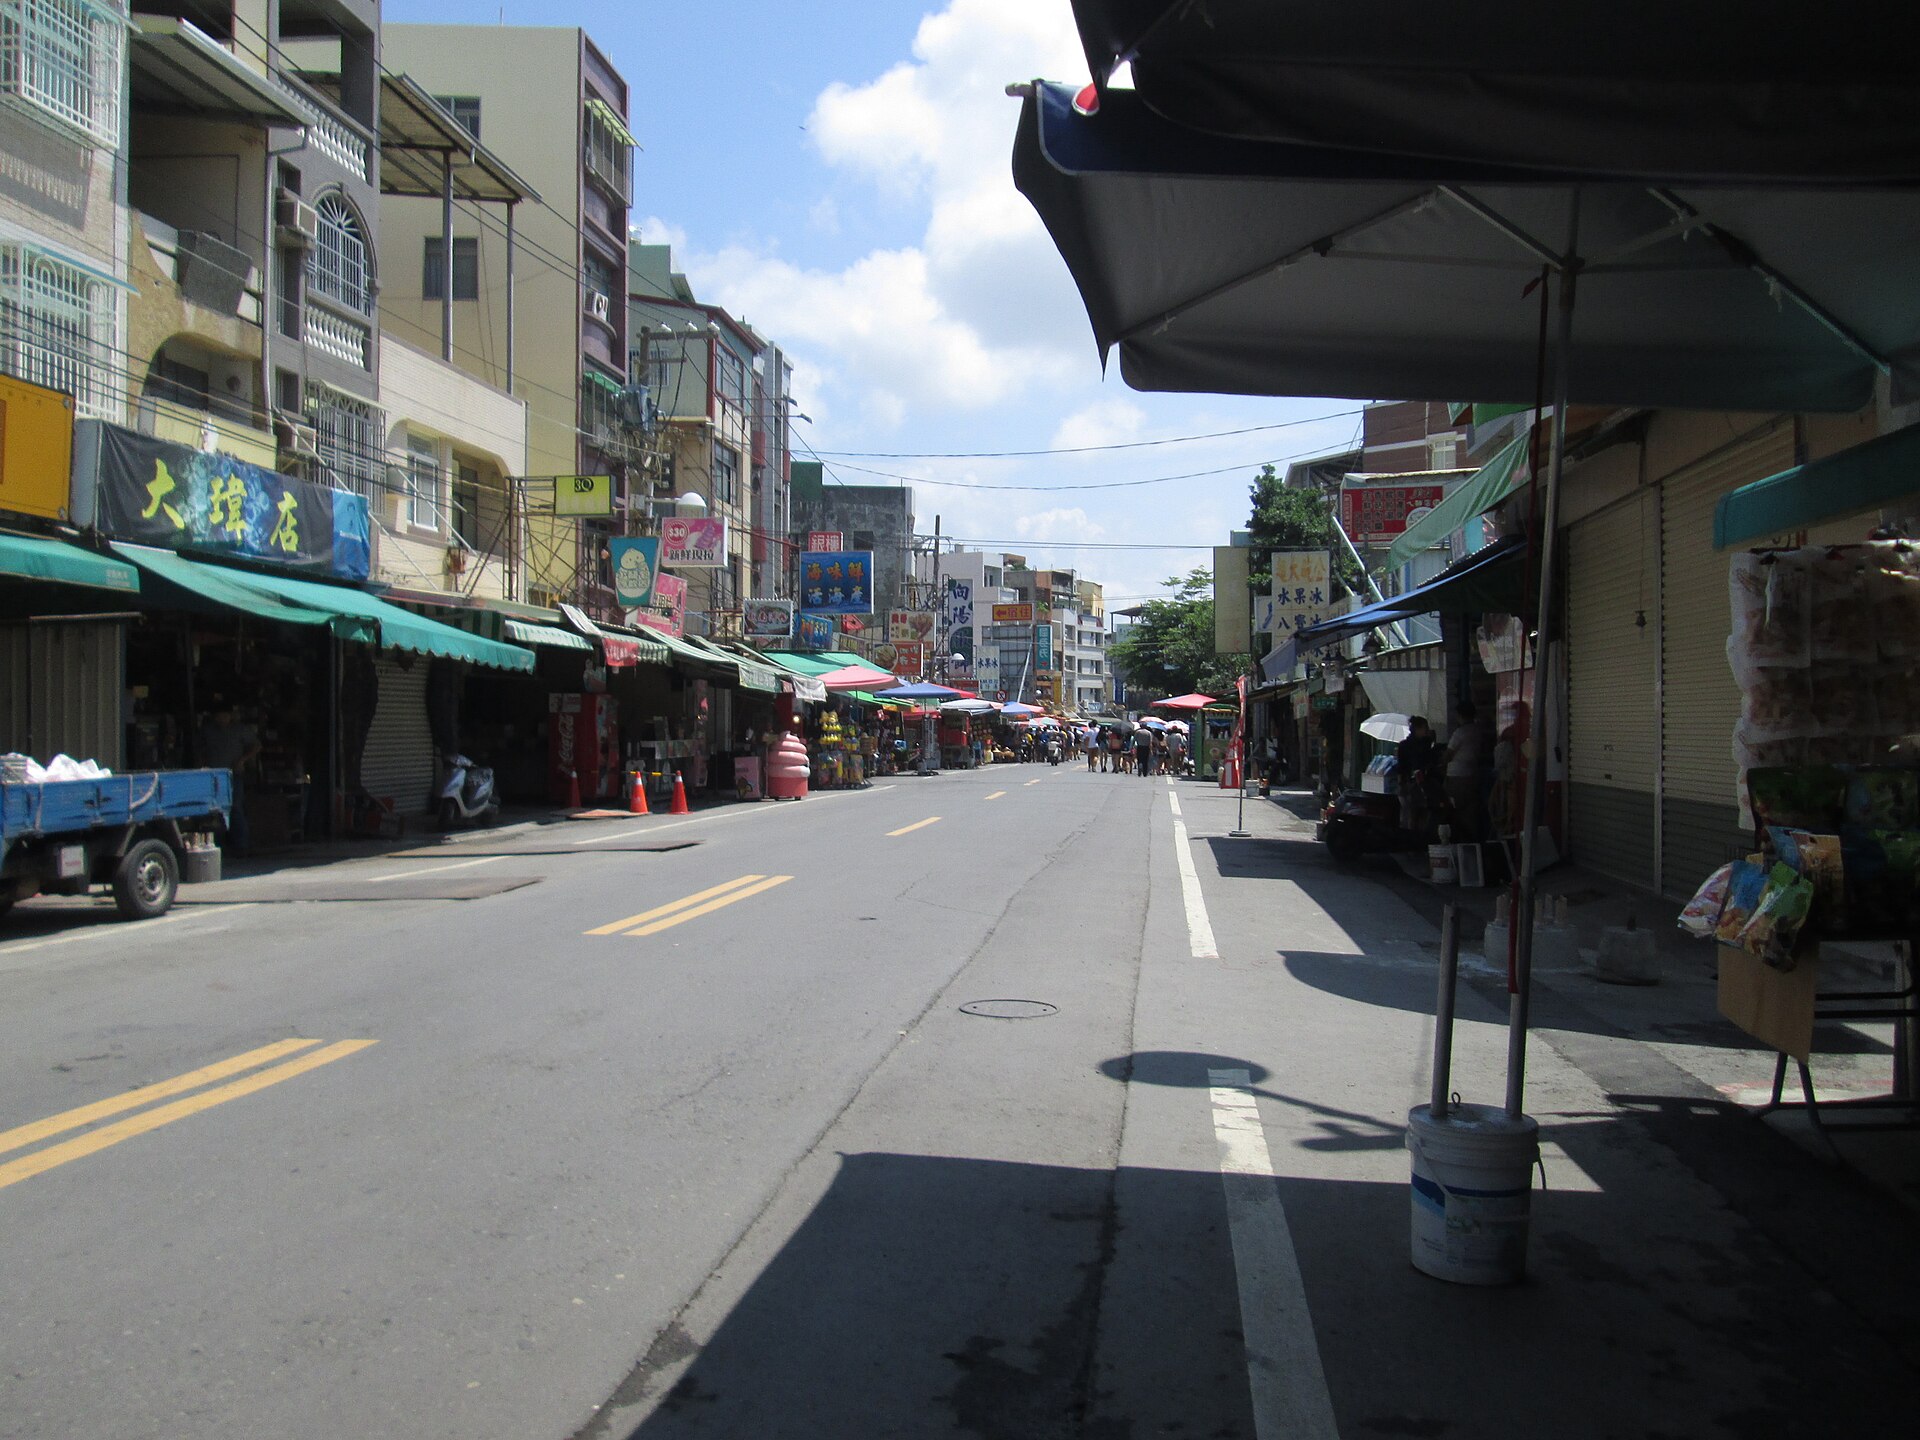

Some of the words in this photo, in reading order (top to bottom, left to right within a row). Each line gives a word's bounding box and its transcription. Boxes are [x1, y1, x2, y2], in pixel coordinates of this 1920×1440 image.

[668, 527, 685, 538] $30
[811, 534, 839, 552] 銀樓
[1278, 587, 1324, 605] 水果冰
